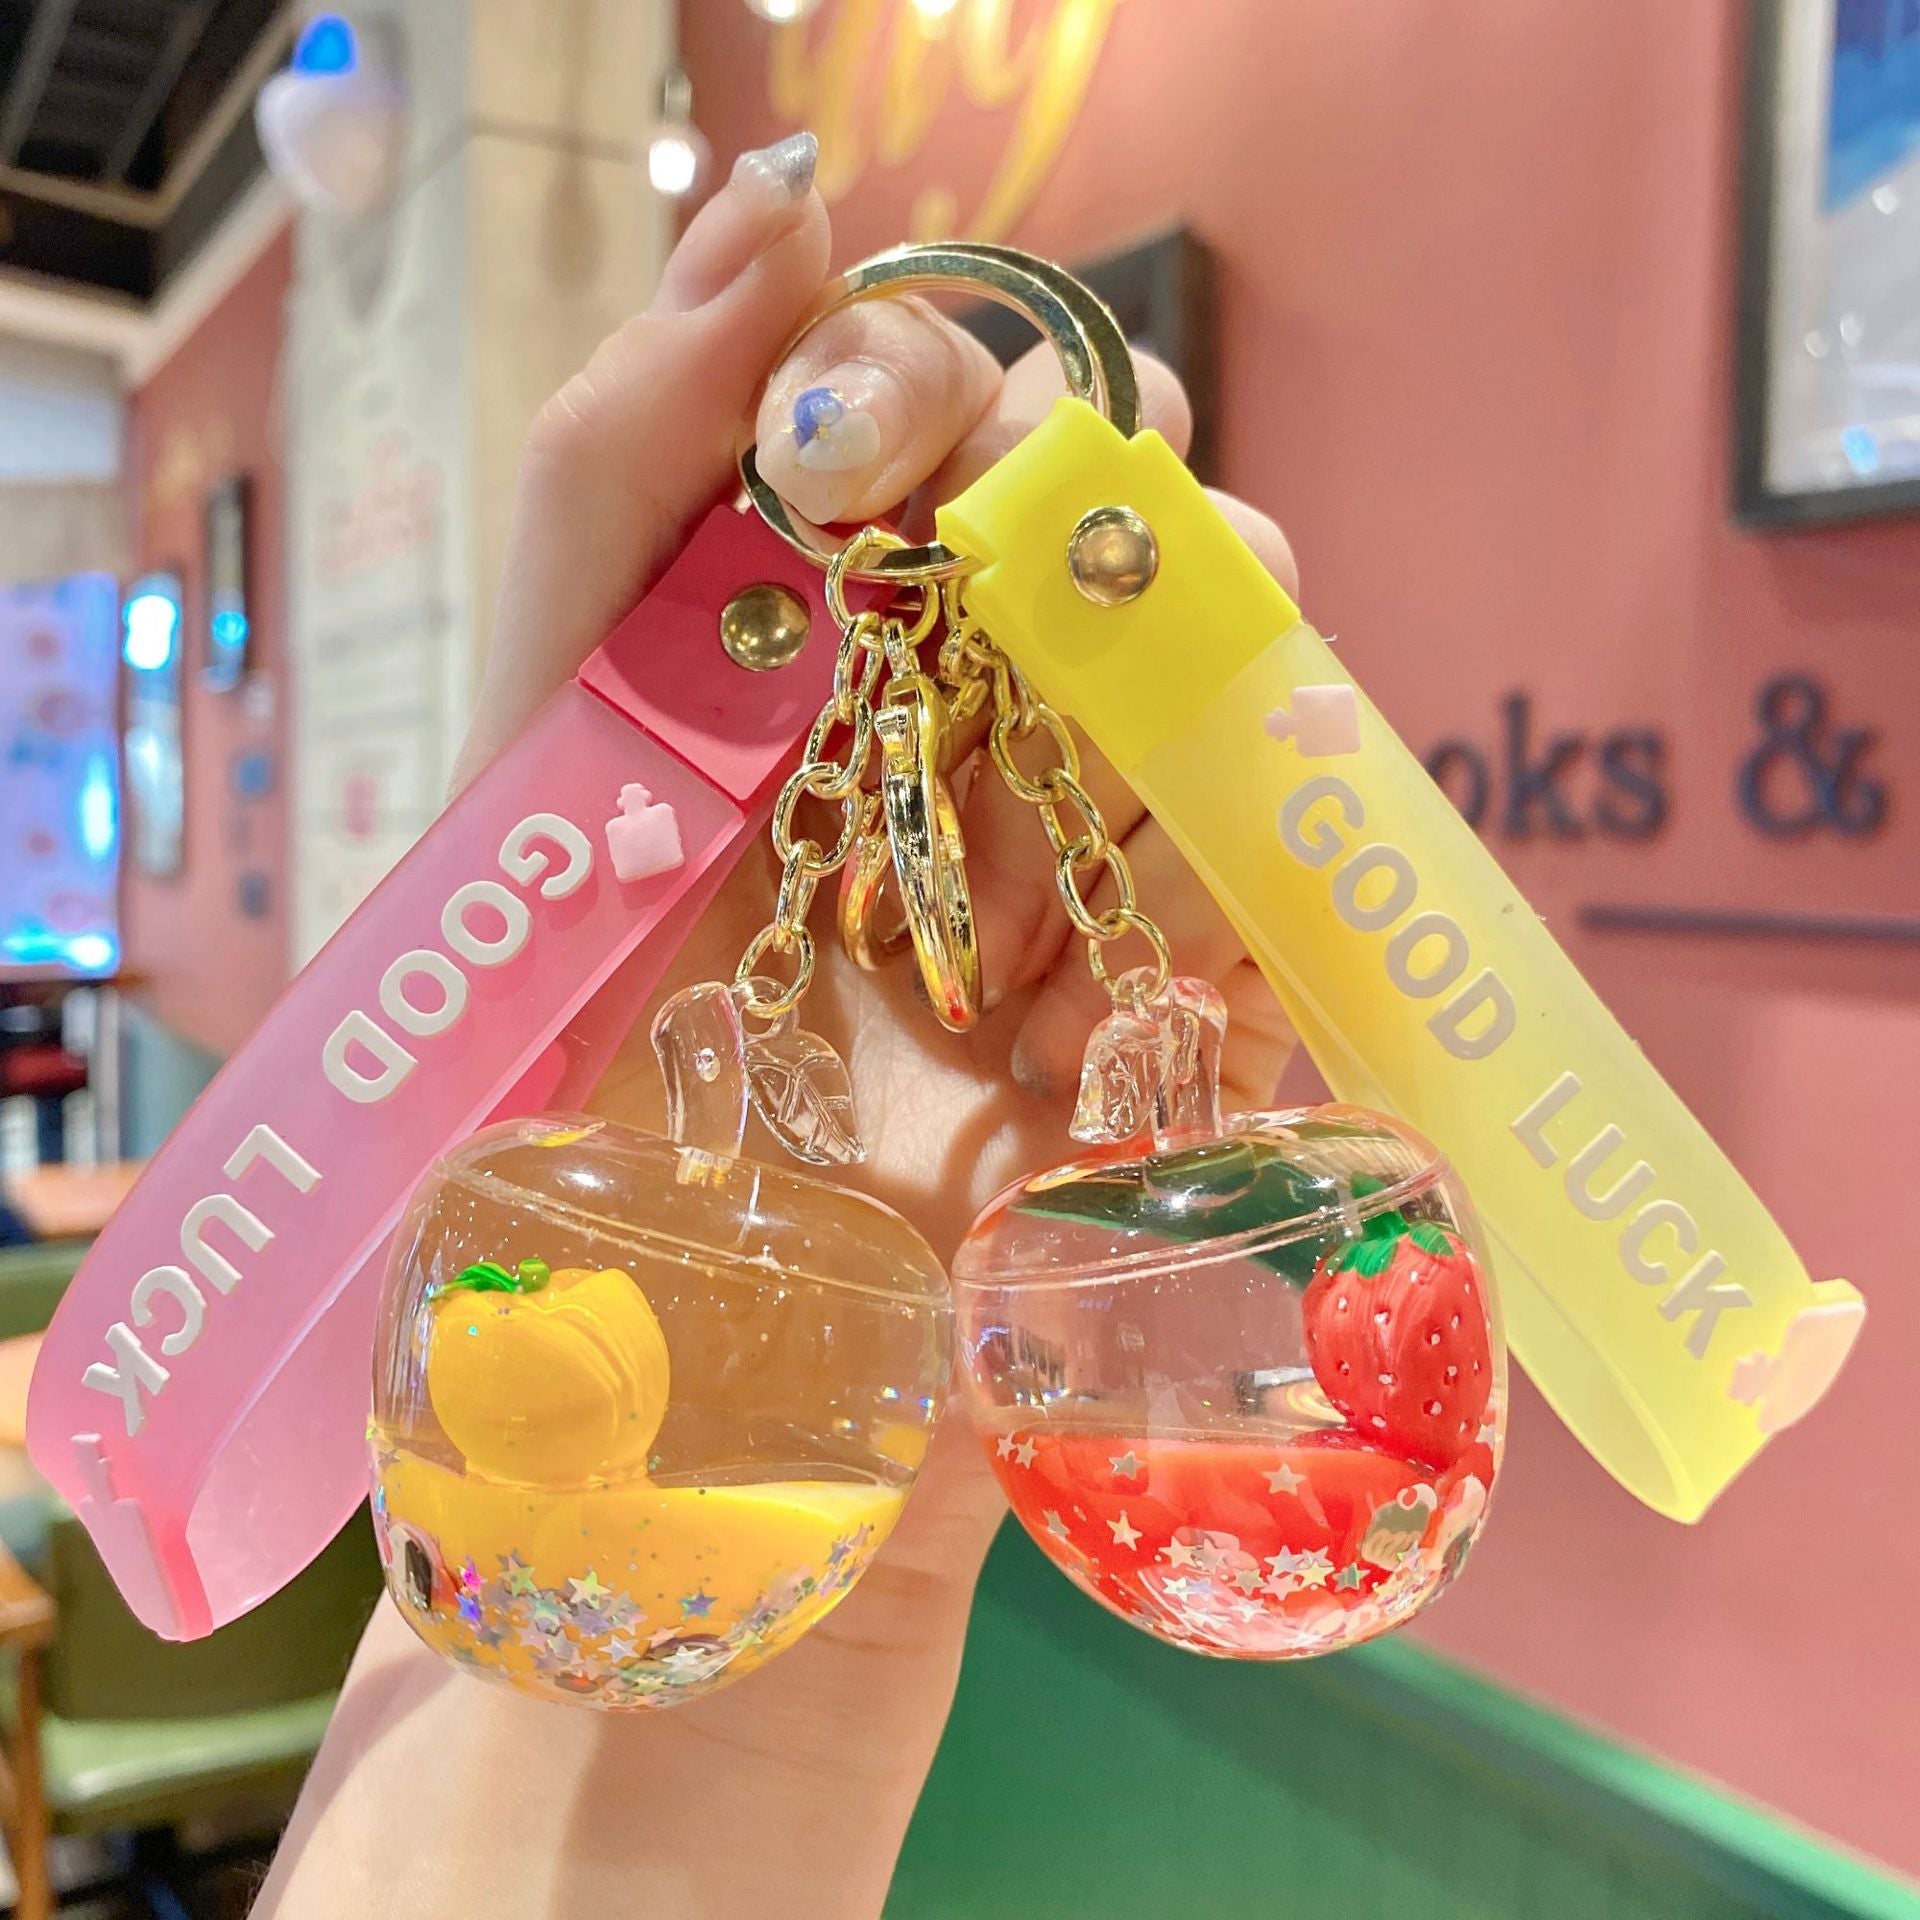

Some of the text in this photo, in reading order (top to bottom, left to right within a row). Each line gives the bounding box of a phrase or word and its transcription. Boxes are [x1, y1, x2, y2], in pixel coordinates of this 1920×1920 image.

[1735, 670, 1889, 843] &
[322, 812, 594, 1103] GOOD
[1277, 774, 1754, 1361] GOOD LUCK
[81, 1123, 323, 1437] LUCK
